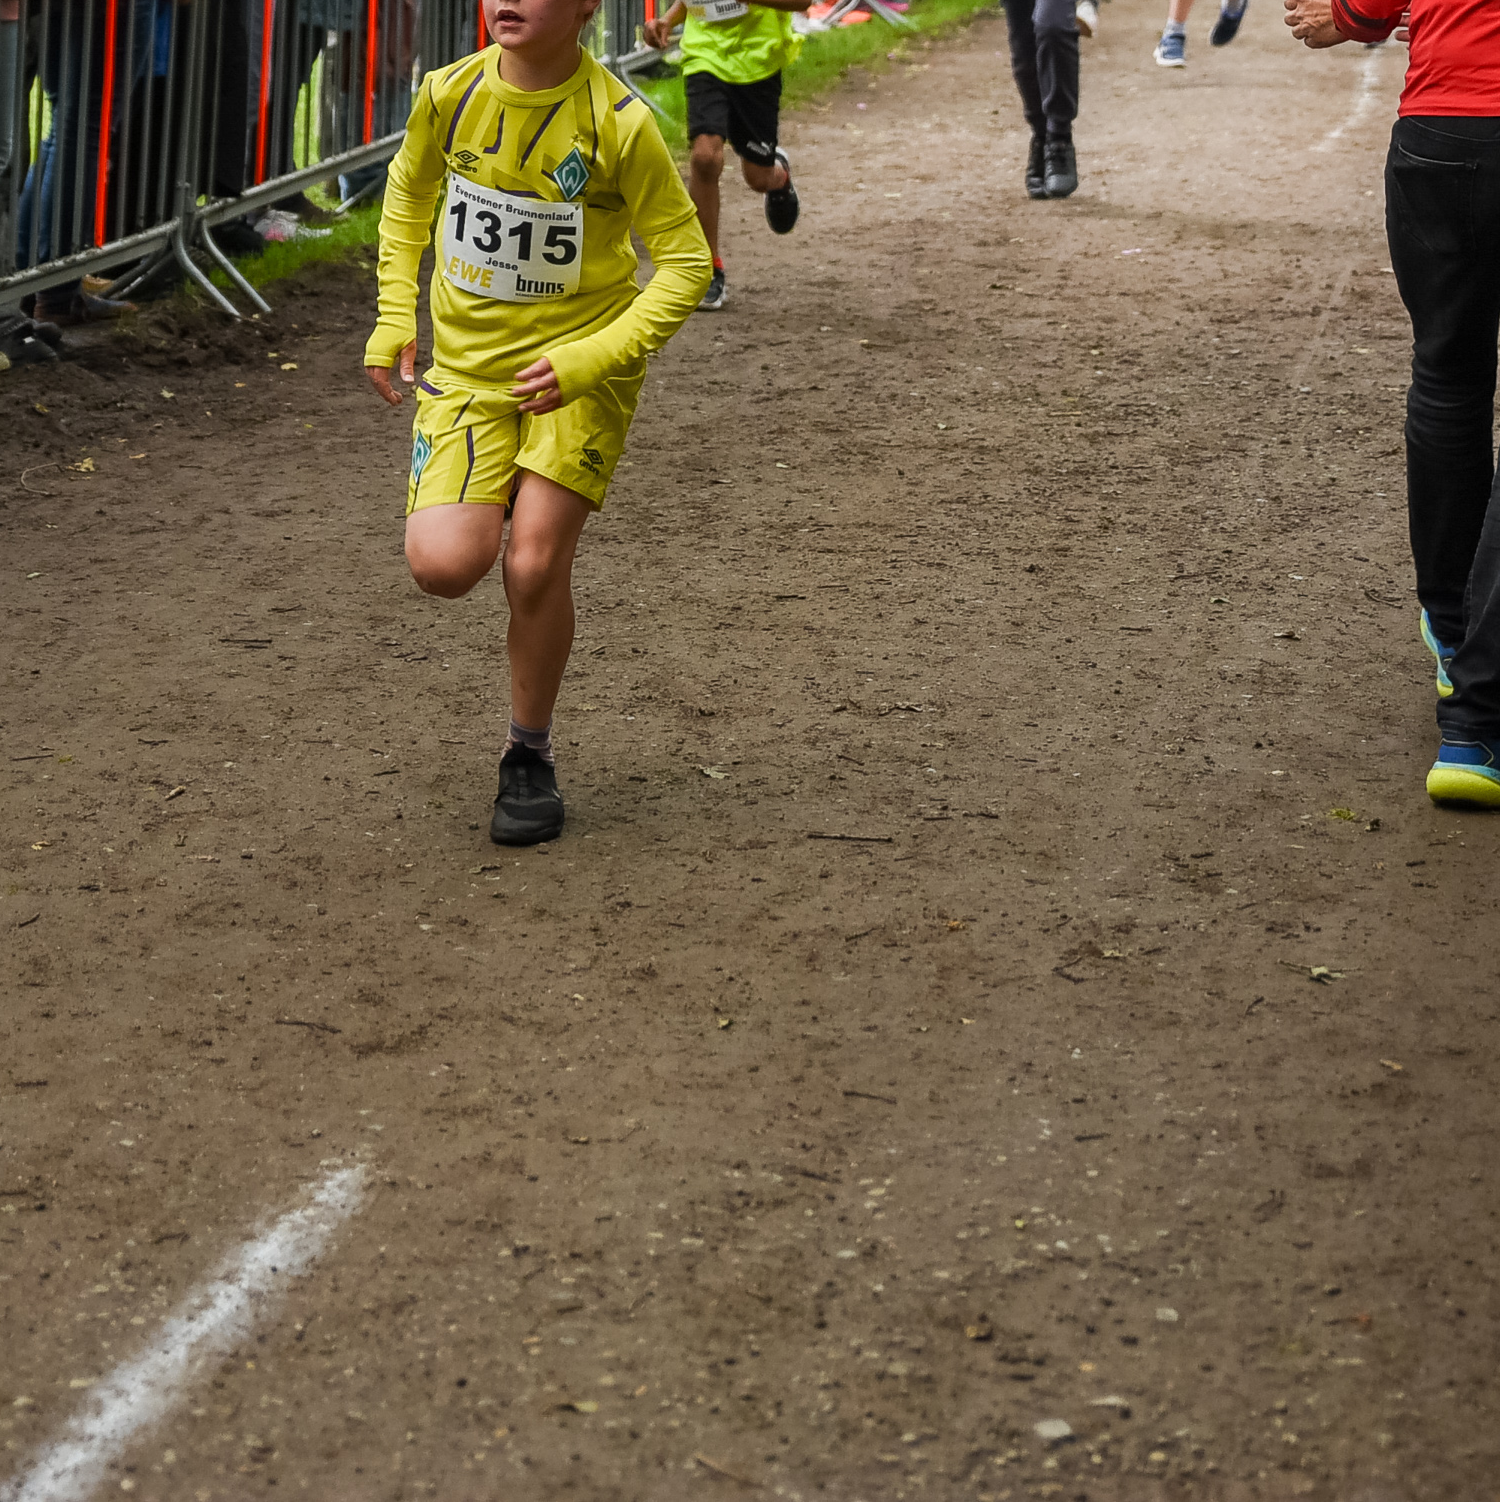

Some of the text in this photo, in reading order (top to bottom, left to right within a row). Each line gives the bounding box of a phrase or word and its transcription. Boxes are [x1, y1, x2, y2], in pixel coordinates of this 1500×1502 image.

[455, 184, 575, 221] Everstener Brunnenlauf
[449, 200, 577, 265] 1315
[449, 255, 494, 288] EWE
[485, 257, 518, 271] Jesse
[515, 274, 565, 294] bruns
